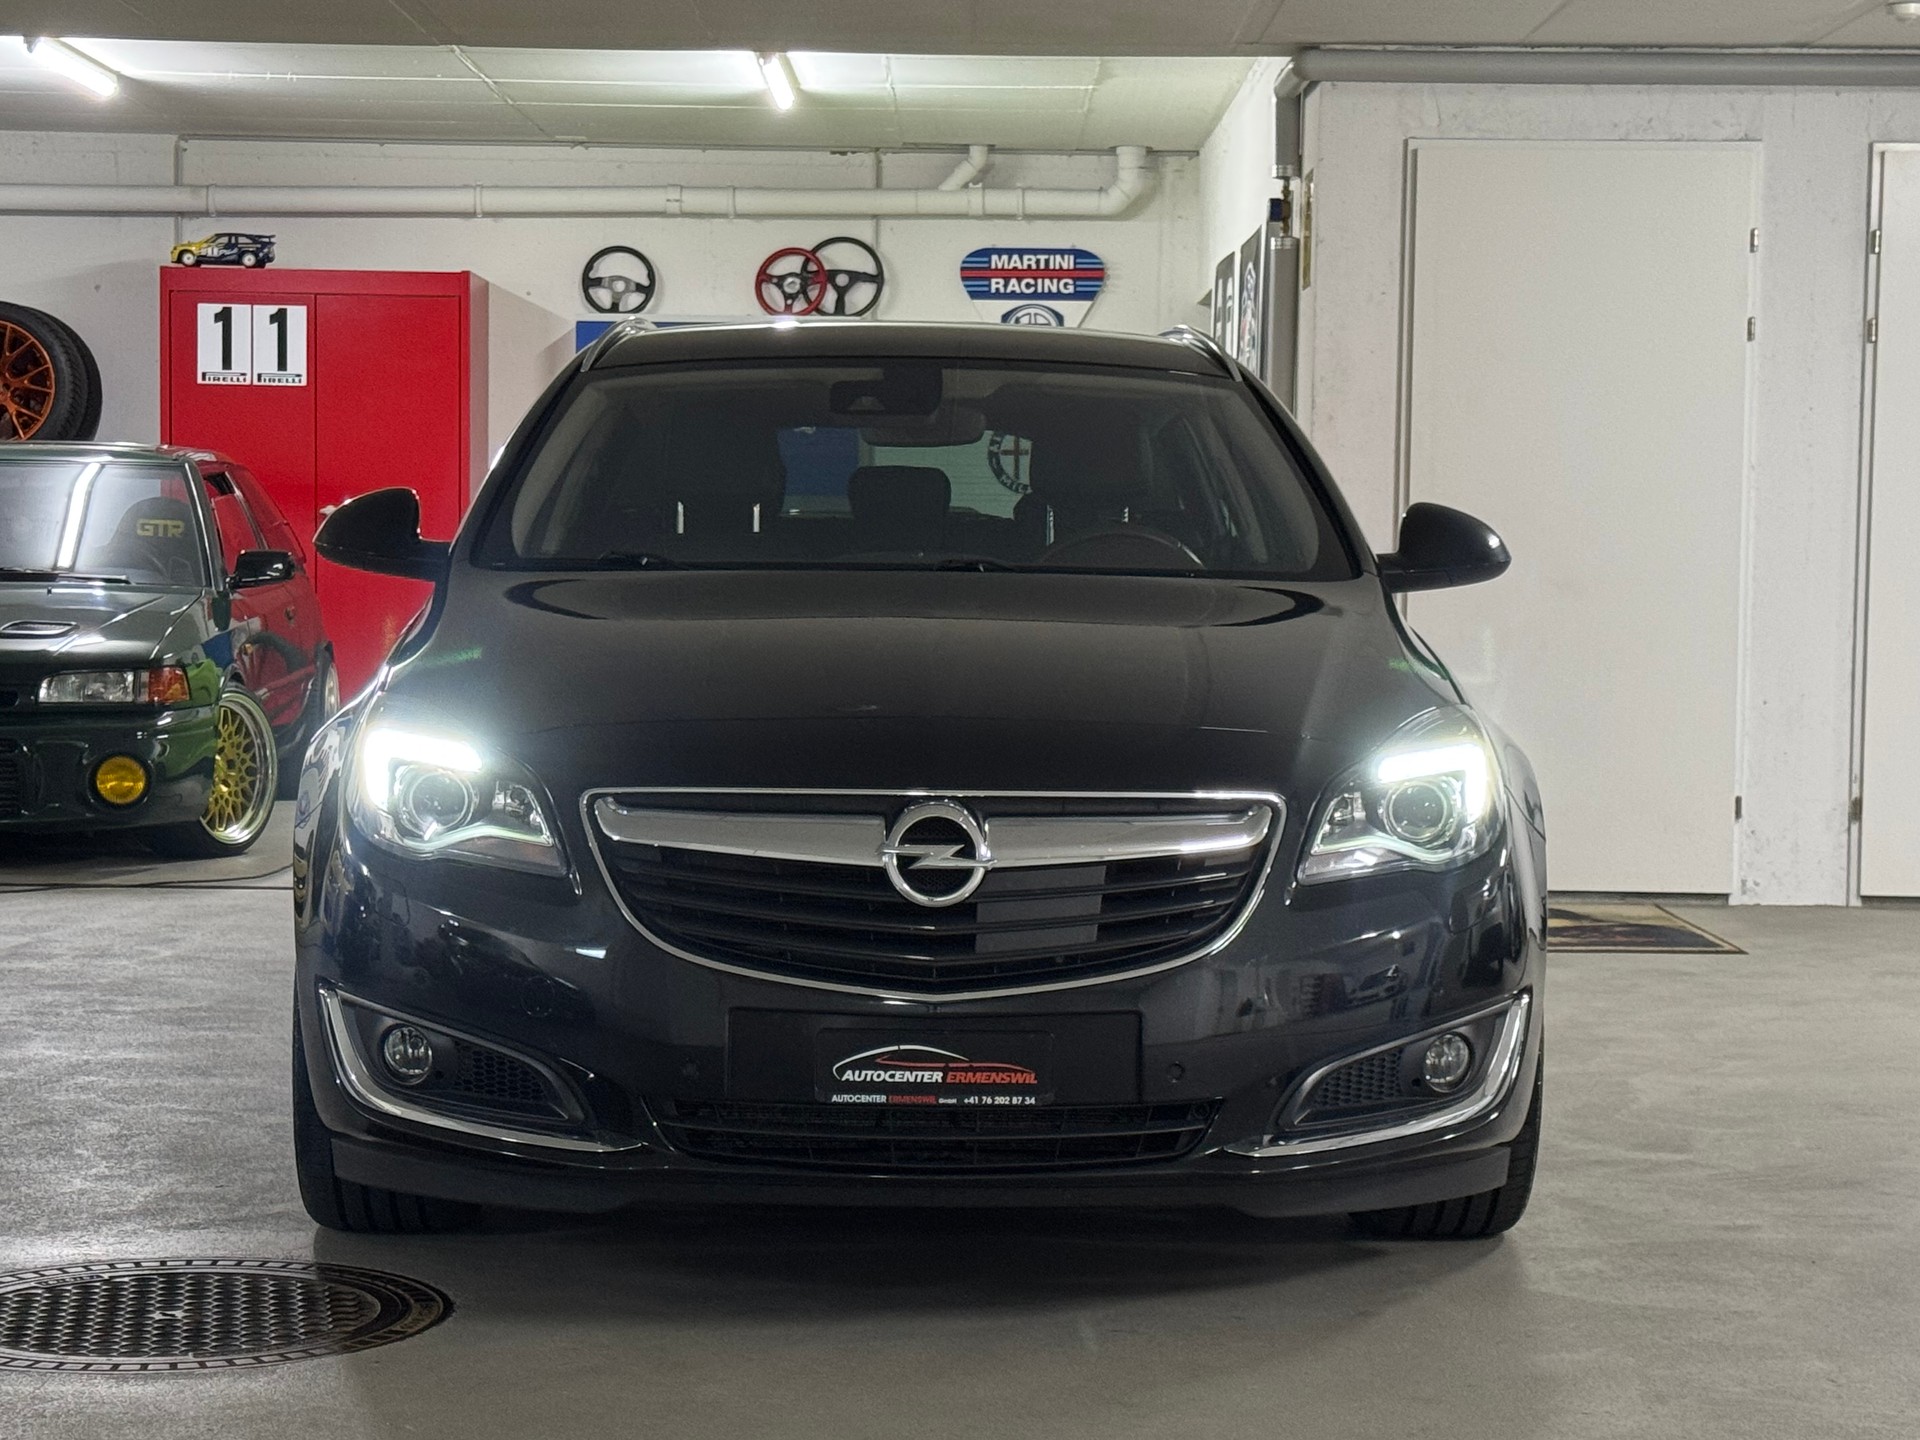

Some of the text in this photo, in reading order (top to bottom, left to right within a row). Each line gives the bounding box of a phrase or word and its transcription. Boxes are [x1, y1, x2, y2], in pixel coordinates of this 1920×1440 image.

[990, 254, 1075, 270] MARTINI
[990, 278, 1075, 294] RACING
[202, 372, 302, 383] PIRELLI PIRELLI
[136, 519, 184, 537] GTR
[841, 1070, 1038, 1084] AUTOCENTER ERMENSWIL
[831, 1094, 887, 1103] AUTOCENTER
[964, 1096, 979, 1104] +41
[981, 1096, 993, 1105] 76
[994, 1096, 1010, 1105] 202
[1012, 1096, 1023, 1105] 87
[1025, 1096, 1036, 1105] 34
